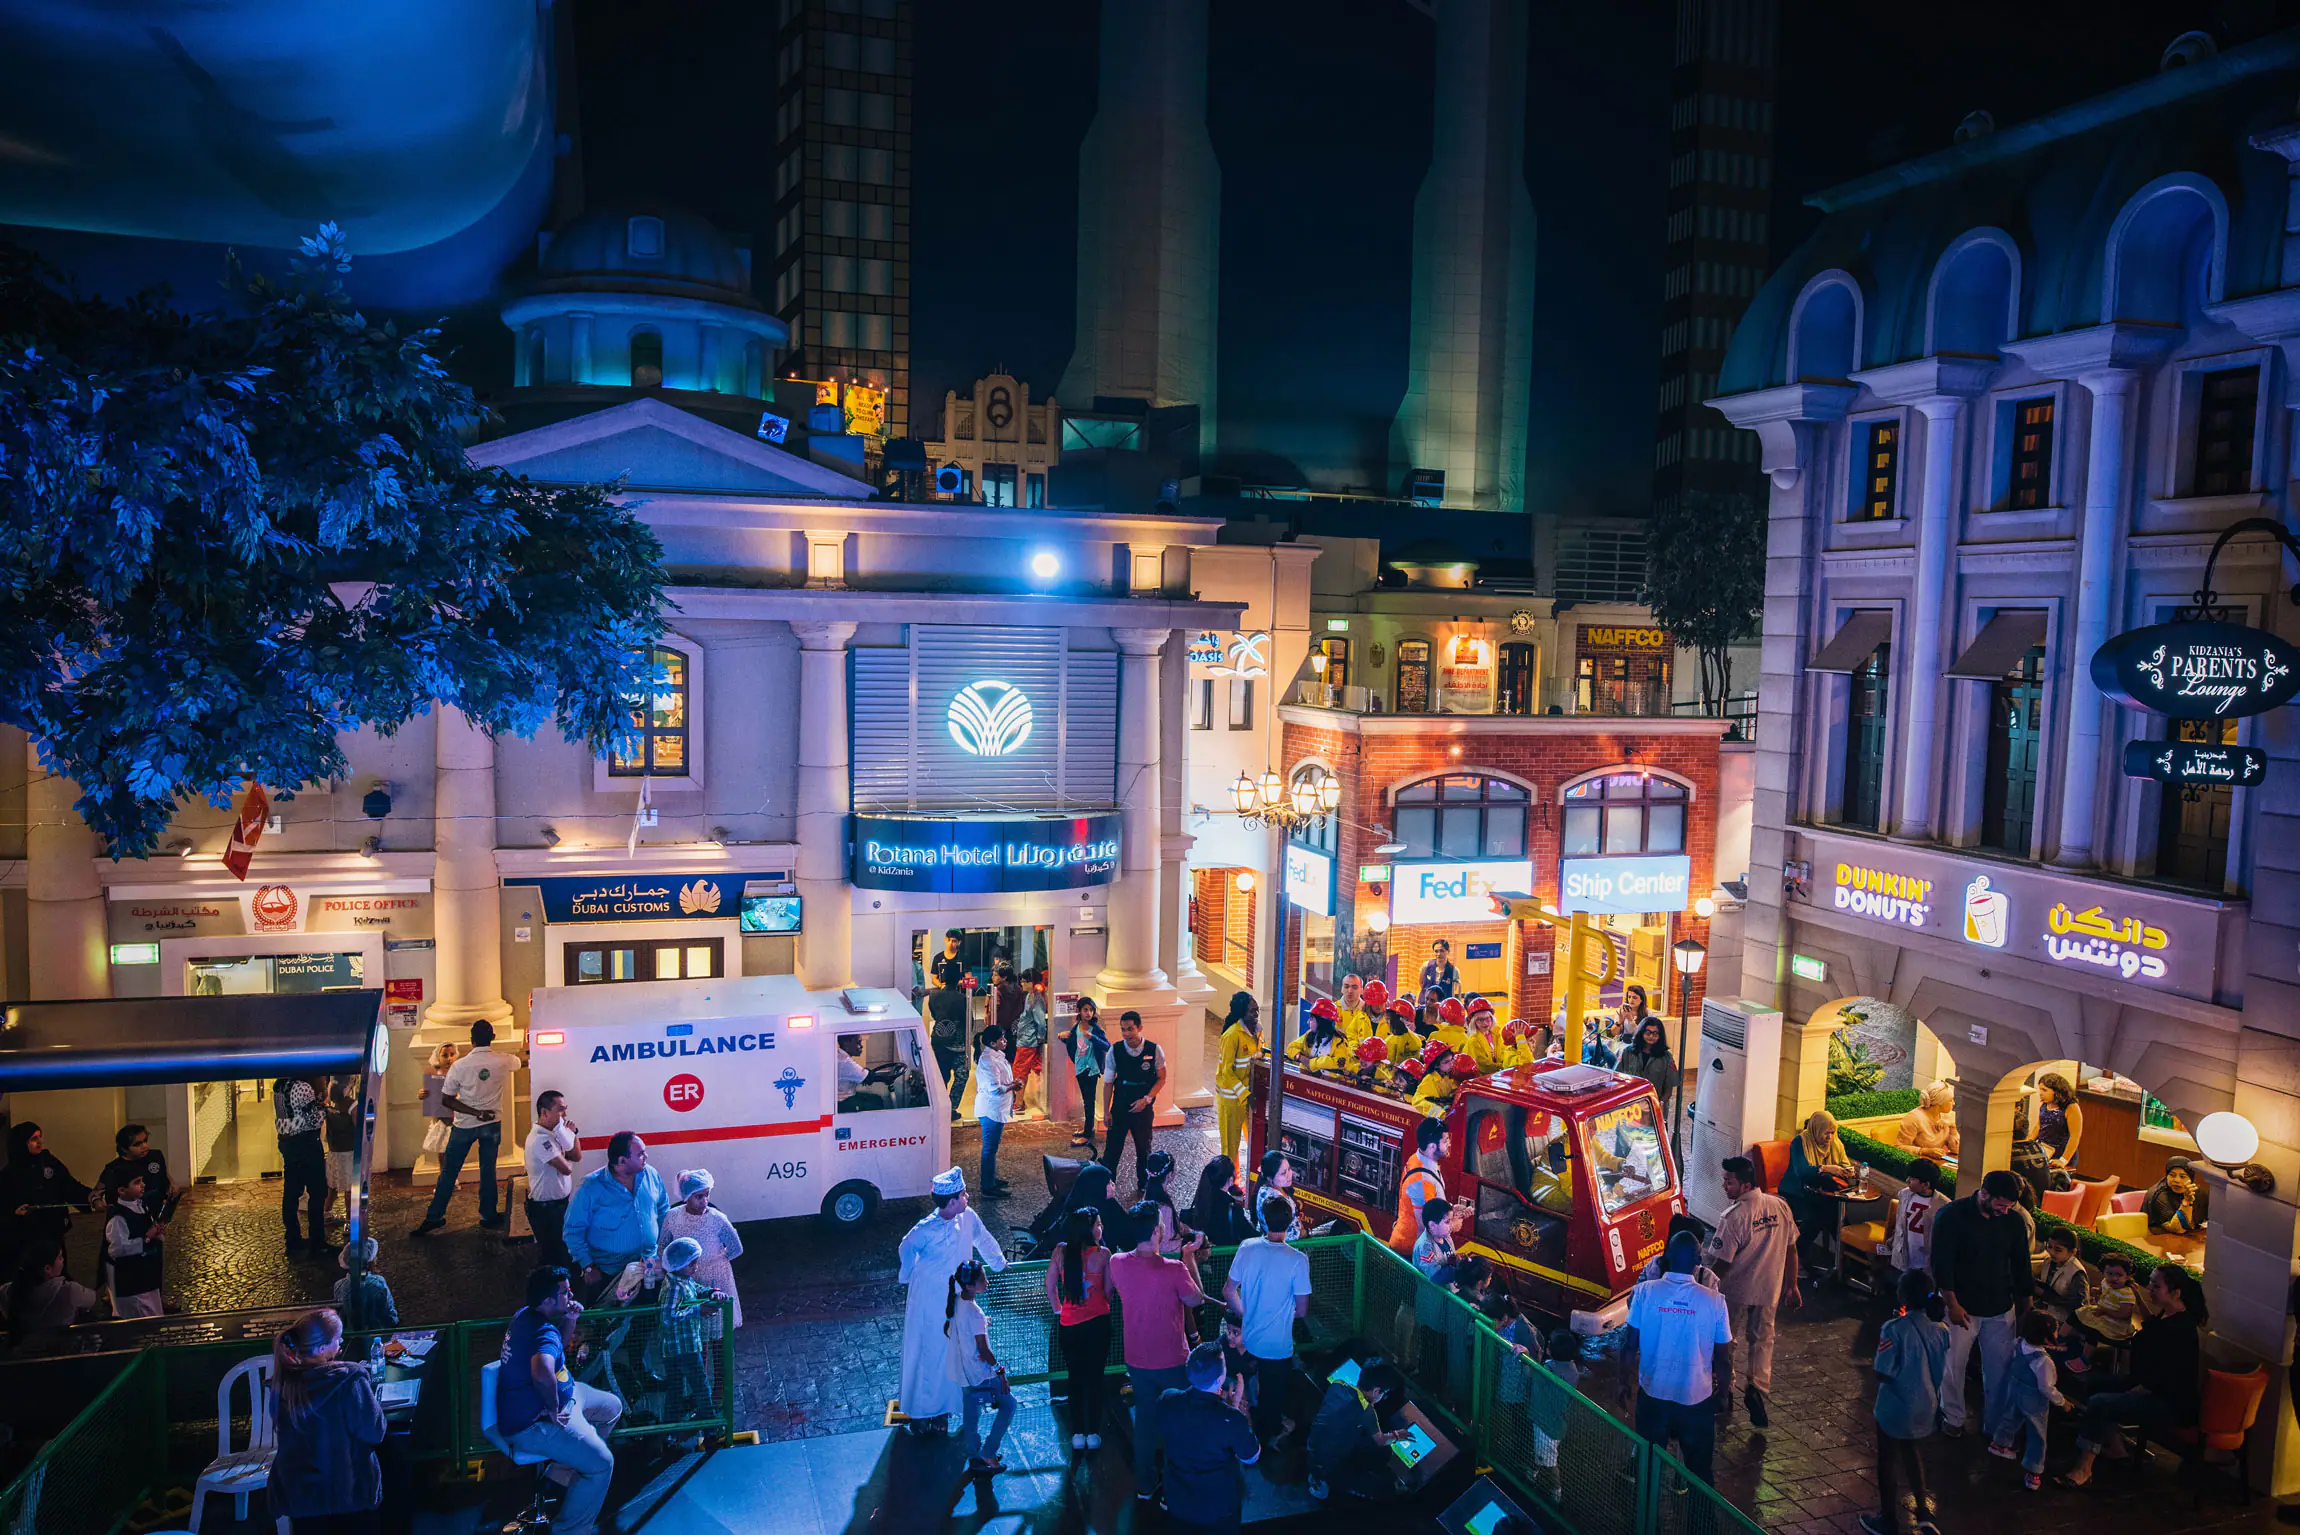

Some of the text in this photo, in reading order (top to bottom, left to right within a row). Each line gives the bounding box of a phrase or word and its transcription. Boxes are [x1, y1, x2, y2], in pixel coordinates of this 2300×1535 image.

[1587, 628, 1664, 647] NAFFCO
[2189, 645, 2242, 657] KIDZANIA'S
[2171, 656, 2257, 679] PARENTS
[2177, 672, 2248, 714] Lounge
[866, 841, 1000, 865] Rotana Hotel
[1007, 843, 1066, 868] روتانا
[878, 866, 914, 876] KidZania
[1836, 863, 1932, 902] DUNKIN'
[572, 883, 670, 906] جمارك دبي
[1420, 871, 1497, 899] FedEx
[1567, 871, 1685, 901] Ship Center
[324, 899, 418, 911] POLICE OFFICE
[572, 902, 670, 914] DUBAI CUSTOMS
[1835, 886, 1928, 927] DONUTS
[2049, 902, 2170, 950] دانكن
[2046, 934, 2168, 979] دونتس
[279, 964, 335, 974] DUBAI POLICE
[590, 1033, 776, 1063] AMBULANCE
[669, 1083, 700, 1102] ER
[1285, 1080, 1295, 1090] 16
[1306, 1088, 1411, 1126] NAFFCO FIRE FIGHTING VEHICLE
[1594, 1103, 1642, 1133] NAFFCO
[838, 1135, 927, 1151] EMERGENCY
[767, 1161, 807, 1180] A95
[1301, 1191, 1312, 1200] LIFE
[1312, 1195, 1325, 1205] WITH
[1637, 1240, 1665, 1261] NAFFCO
[1658, 1306, 1696, 1316] REPORTER
